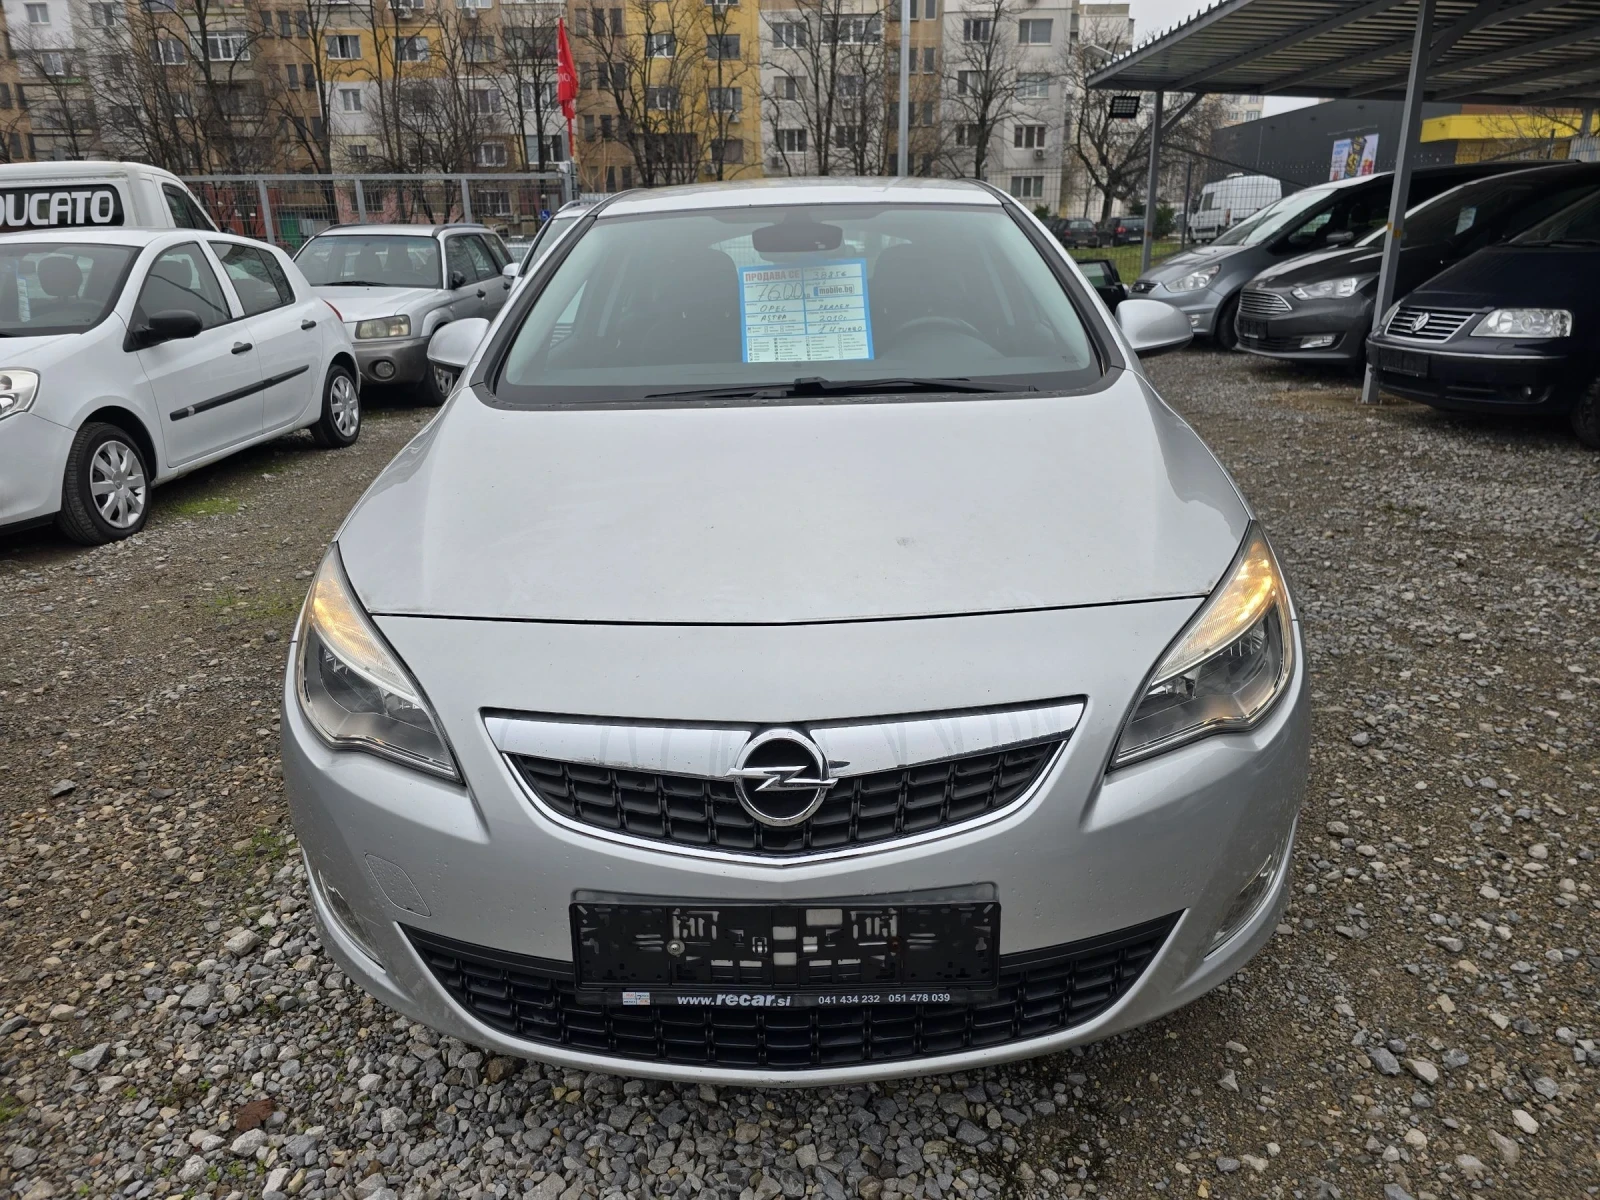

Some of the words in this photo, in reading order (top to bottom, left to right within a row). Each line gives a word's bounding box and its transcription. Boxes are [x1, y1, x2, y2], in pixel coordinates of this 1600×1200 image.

[0, 190, 115, 227] UCATO
[745, 270, 787, 282] ПРОДАВА
[788, 269, 800, 279] СЕ
[755, 282, 803, 302] 7600
[818, 285, 854, 295] mobile.bg
[760, 304, 787, 312] OPEL
[760, 314, 787, 322] ASTRA
[677, 992, 791, 1007] www.recar.si
[818, 995, 837, 1004] 041
[840, 995, 859, 1004] 434
[861, 994, 880, 1003] 232
[888, 994, 907, 1003] 051
[909, 993, 929, 1002] 478
[931, 992, 951, 1002] 039
